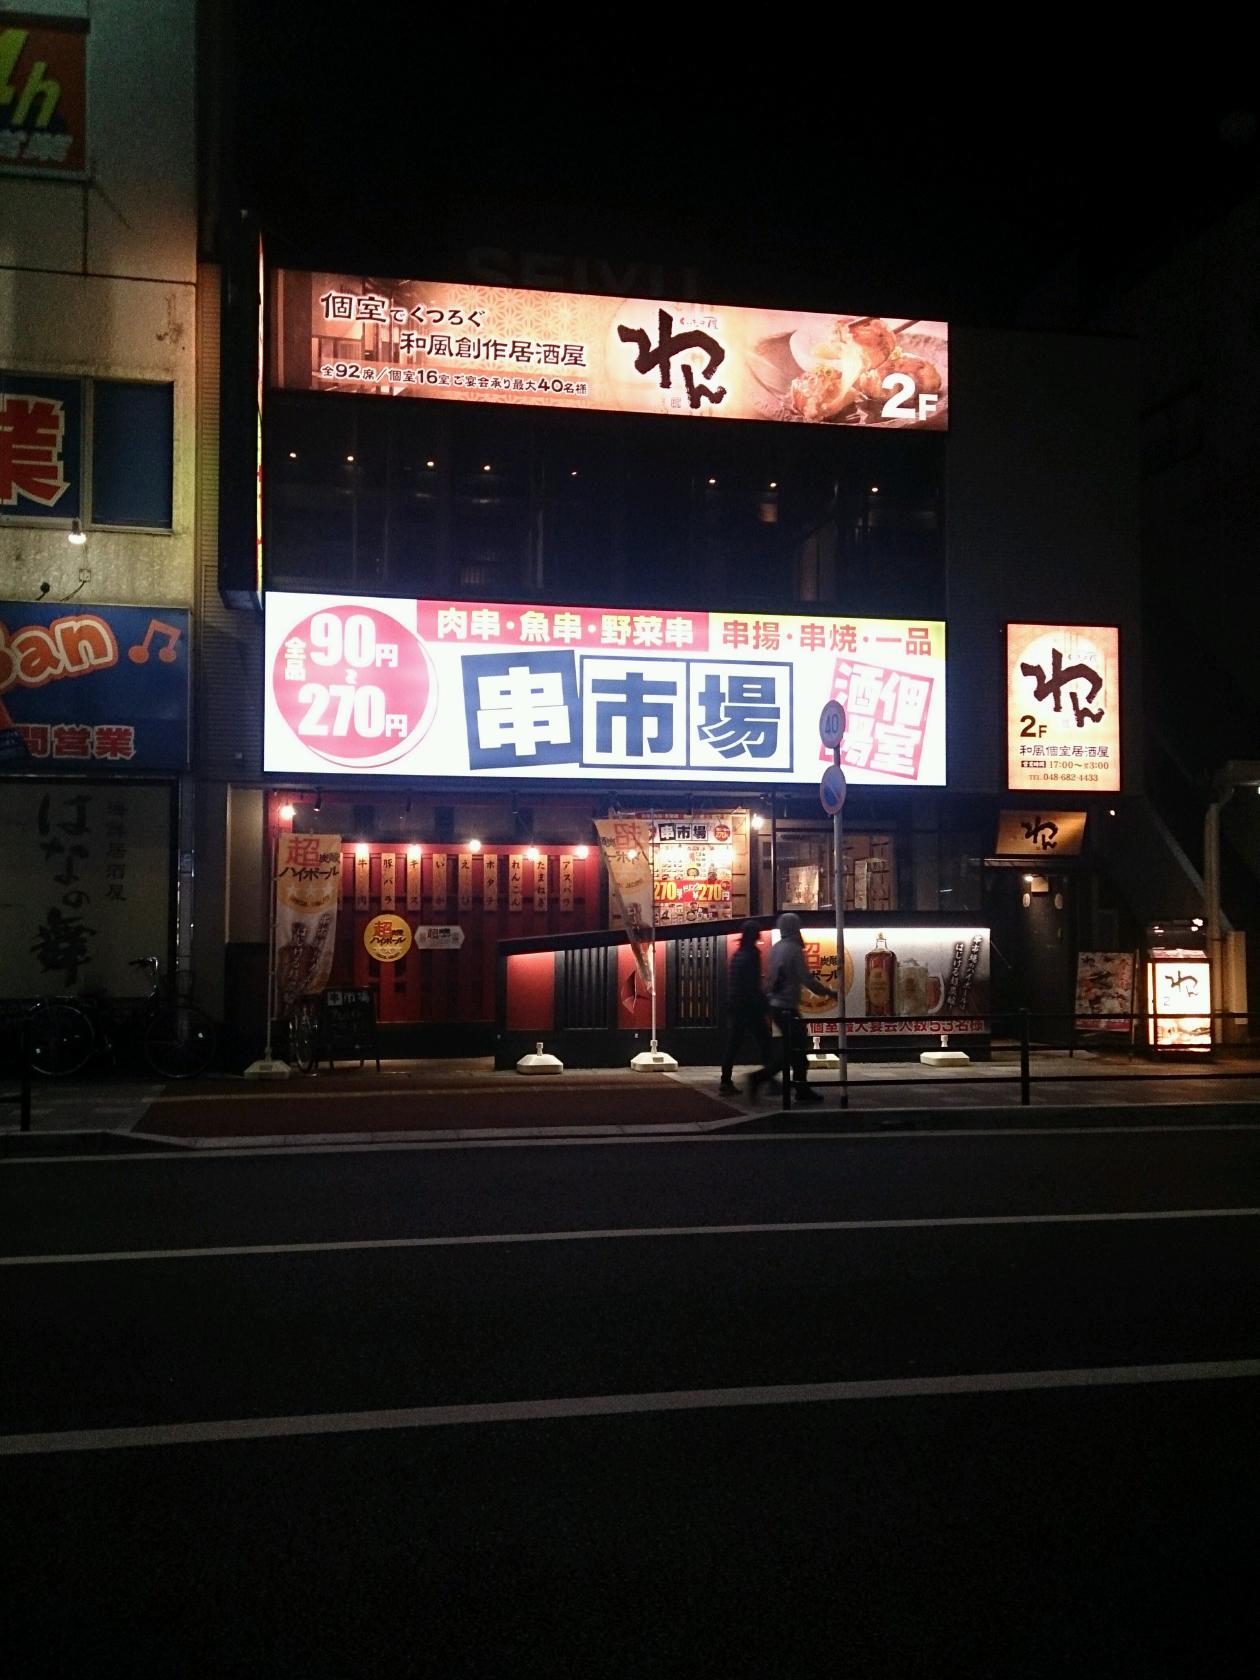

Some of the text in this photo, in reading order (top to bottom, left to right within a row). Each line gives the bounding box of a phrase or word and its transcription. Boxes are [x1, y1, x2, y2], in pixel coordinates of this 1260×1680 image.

[320, 292, 486, 328] 個室でくつろぐ
[400, 332, 586, 367] 和風創作居酒屋
[617, 308, 727, 409] わん
[881, 373, 938, 421] 2F
[310, 613, 399, 668] 90円
[437, 607, 693, 648] 肉串・魚串・野菜串
[722, 619, 932, 657] 串揚・串焼・一品
[1020, 648, 1105, 728] わん
[297, 683, 408, 738] 270円
[476, 666, 783, 760] 串市場
[1020, 715, 1047, 738] 2F
[1019, 745, 1110, 758] 和風個室居酒屋
[1021, 816, 1058, 850] わん
[279, 866, 340, 881] ハイボール
[510, 861, 521, 906] れんこん
